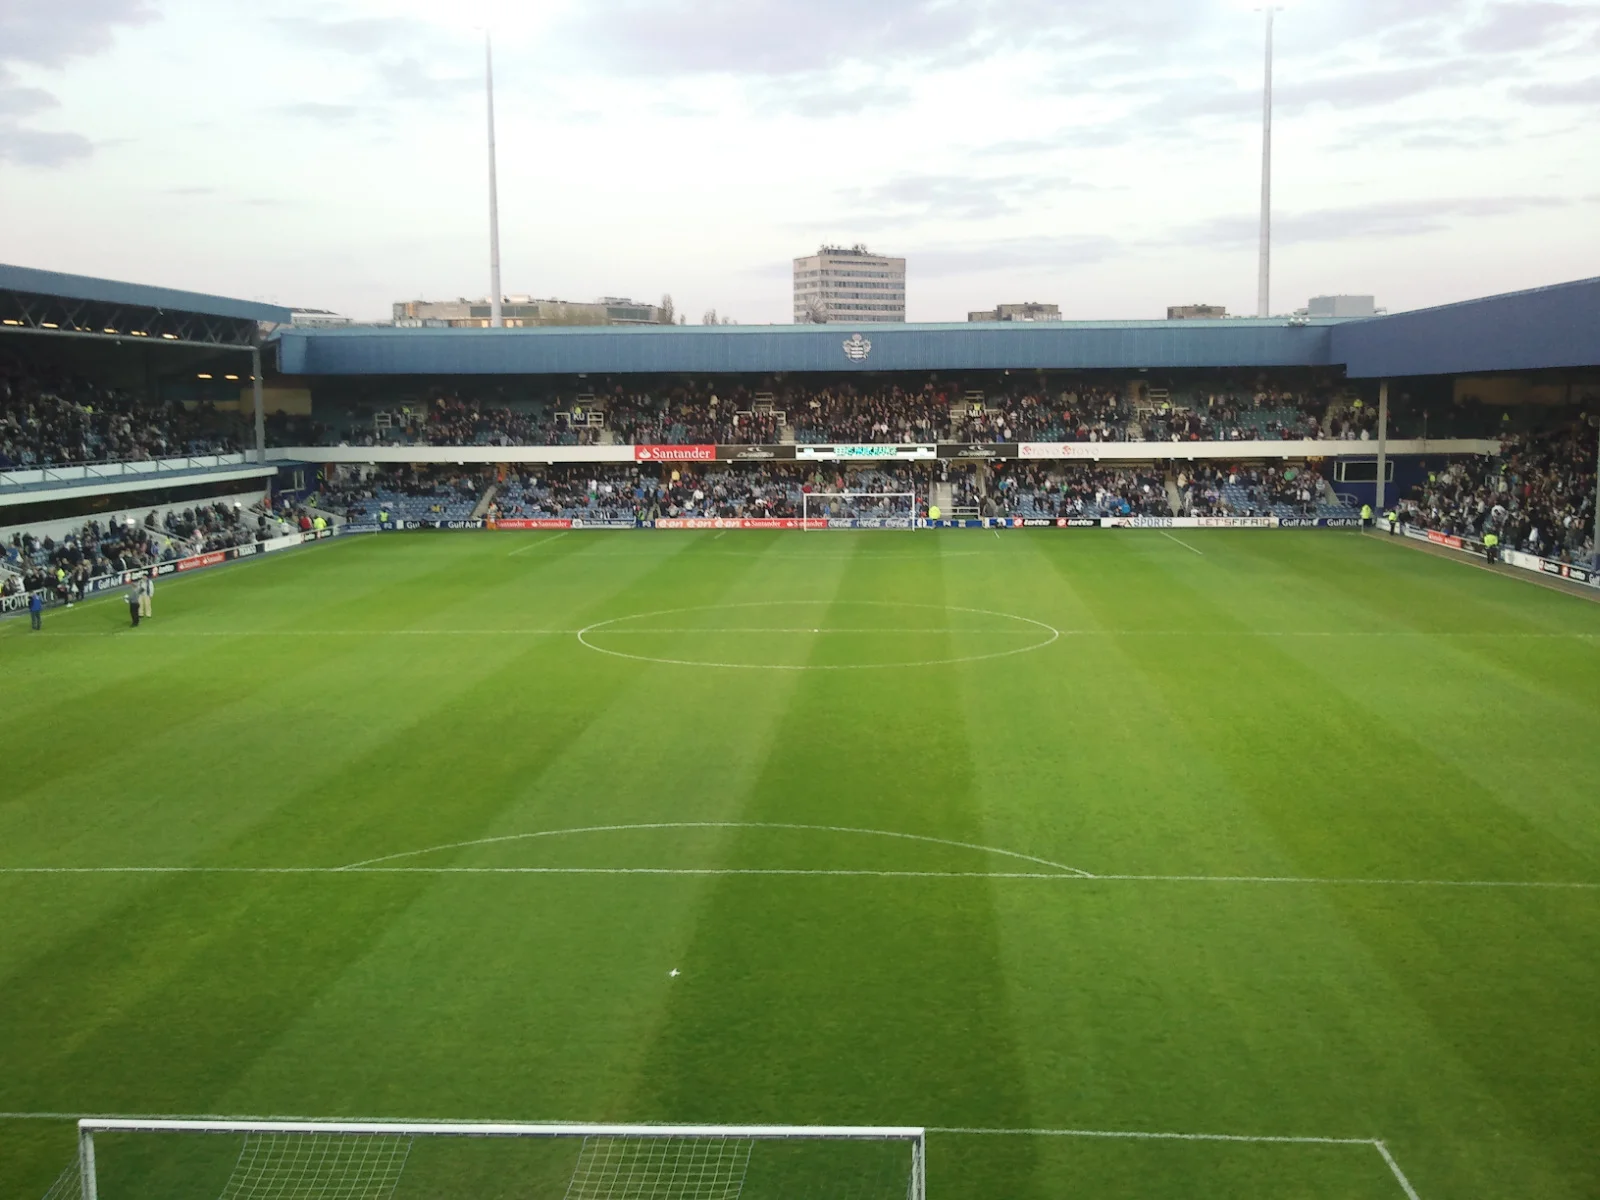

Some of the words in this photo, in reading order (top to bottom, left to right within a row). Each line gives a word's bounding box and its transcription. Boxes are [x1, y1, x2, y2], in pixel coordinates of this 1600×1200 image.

[652, 447, 710, 459] Santander
[447, 520, 465, 529] Gulf
[465, 521, 477, 529] Air
[537, 520, 568, 528] Santander
[751, 519, 781, 528] Santander
[1023, 518, 1050, 526] lotto
[1067, 518, 1094, 526] lotto
[1133, 517, 1173, 527] SPORTS
[1281, 518, 1298, 527] Gulf
[1299, 518, 1312, 527] Air
[1326, 518, 1343, 527] Gulf
[1344, 518, 1357, 527] Air
